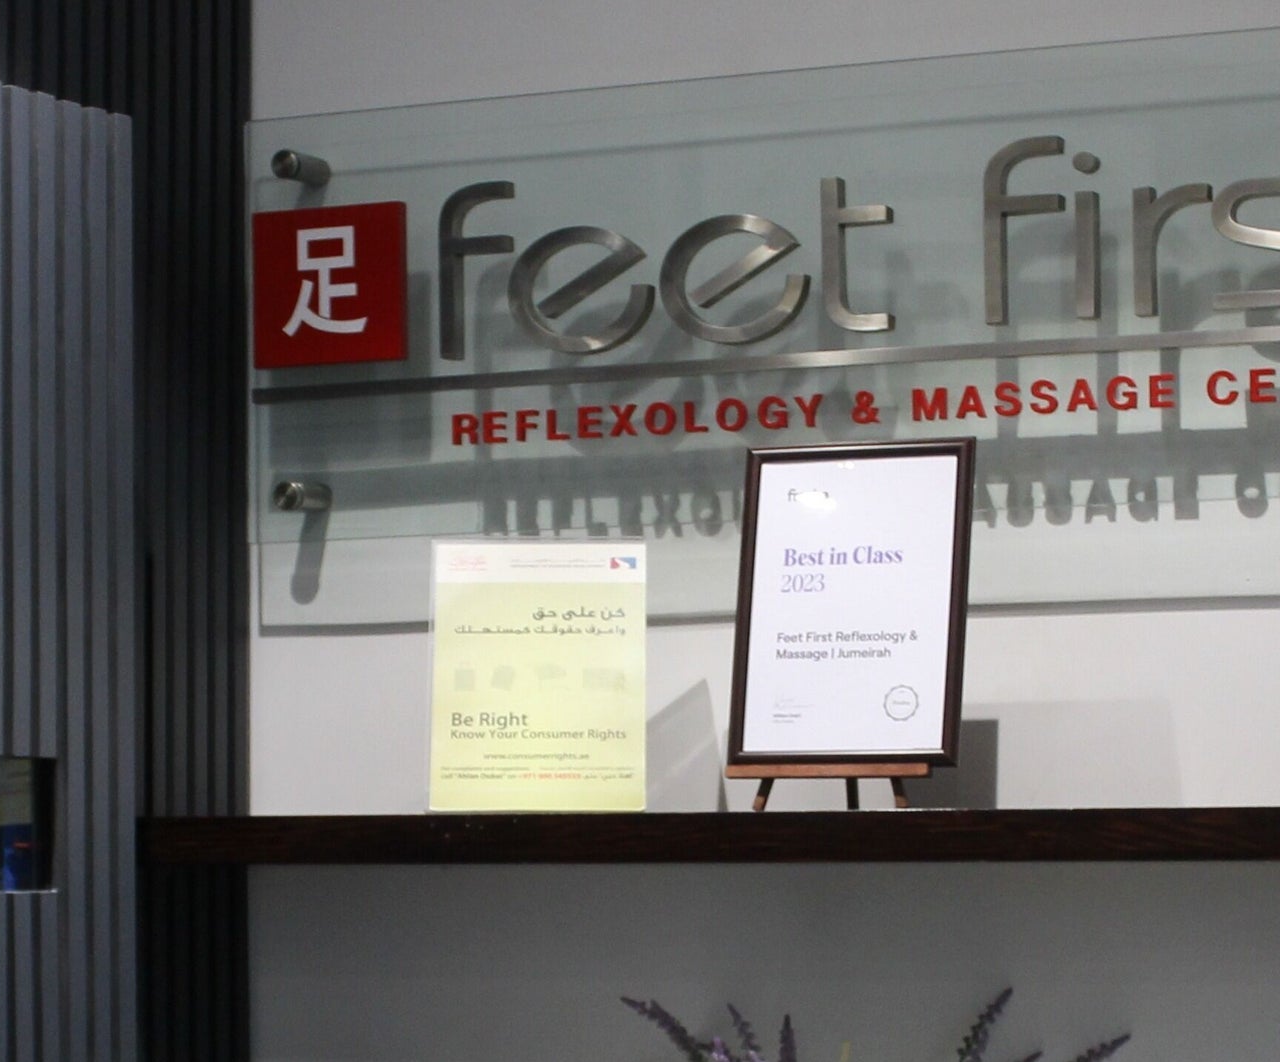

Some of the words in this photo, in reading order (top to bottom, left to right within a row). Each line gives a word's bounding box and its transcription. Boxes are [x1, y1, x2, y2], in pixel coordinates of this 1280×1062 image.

[438, 177, 894, 361] feet
[282, 226, 367, 338] 足
[450, 393, 823, 446] REFLEXOLOGY
[852, 391, 882, 424] &
[910, 372, 1176, 422] MASSAGE
[783, 548, 824, 567] Best
[829, 548, 848, 564] in
[852, 546, 903, 564] Class
[780, 573, 825, 593] 2023
[601, 607, 626, 621] كن
[776, 631, 802, 643] Feet
[806, 631, 832, 643] First
[835, 629, 906, 645] Reflexology
[909, 630, 918, 641] &
[776, 648, 828, 661] Massage
[837, 646, 891, 659] Jumeirah
[450, 713, 474, 728] Be
[479, 712, 528, 732] Right
[450, 730, 486, 740] Know
[488, 730, 518, 740] Your
[521, 730, 584, 740] Consumer
[587, 729, 627, 743] Rights
